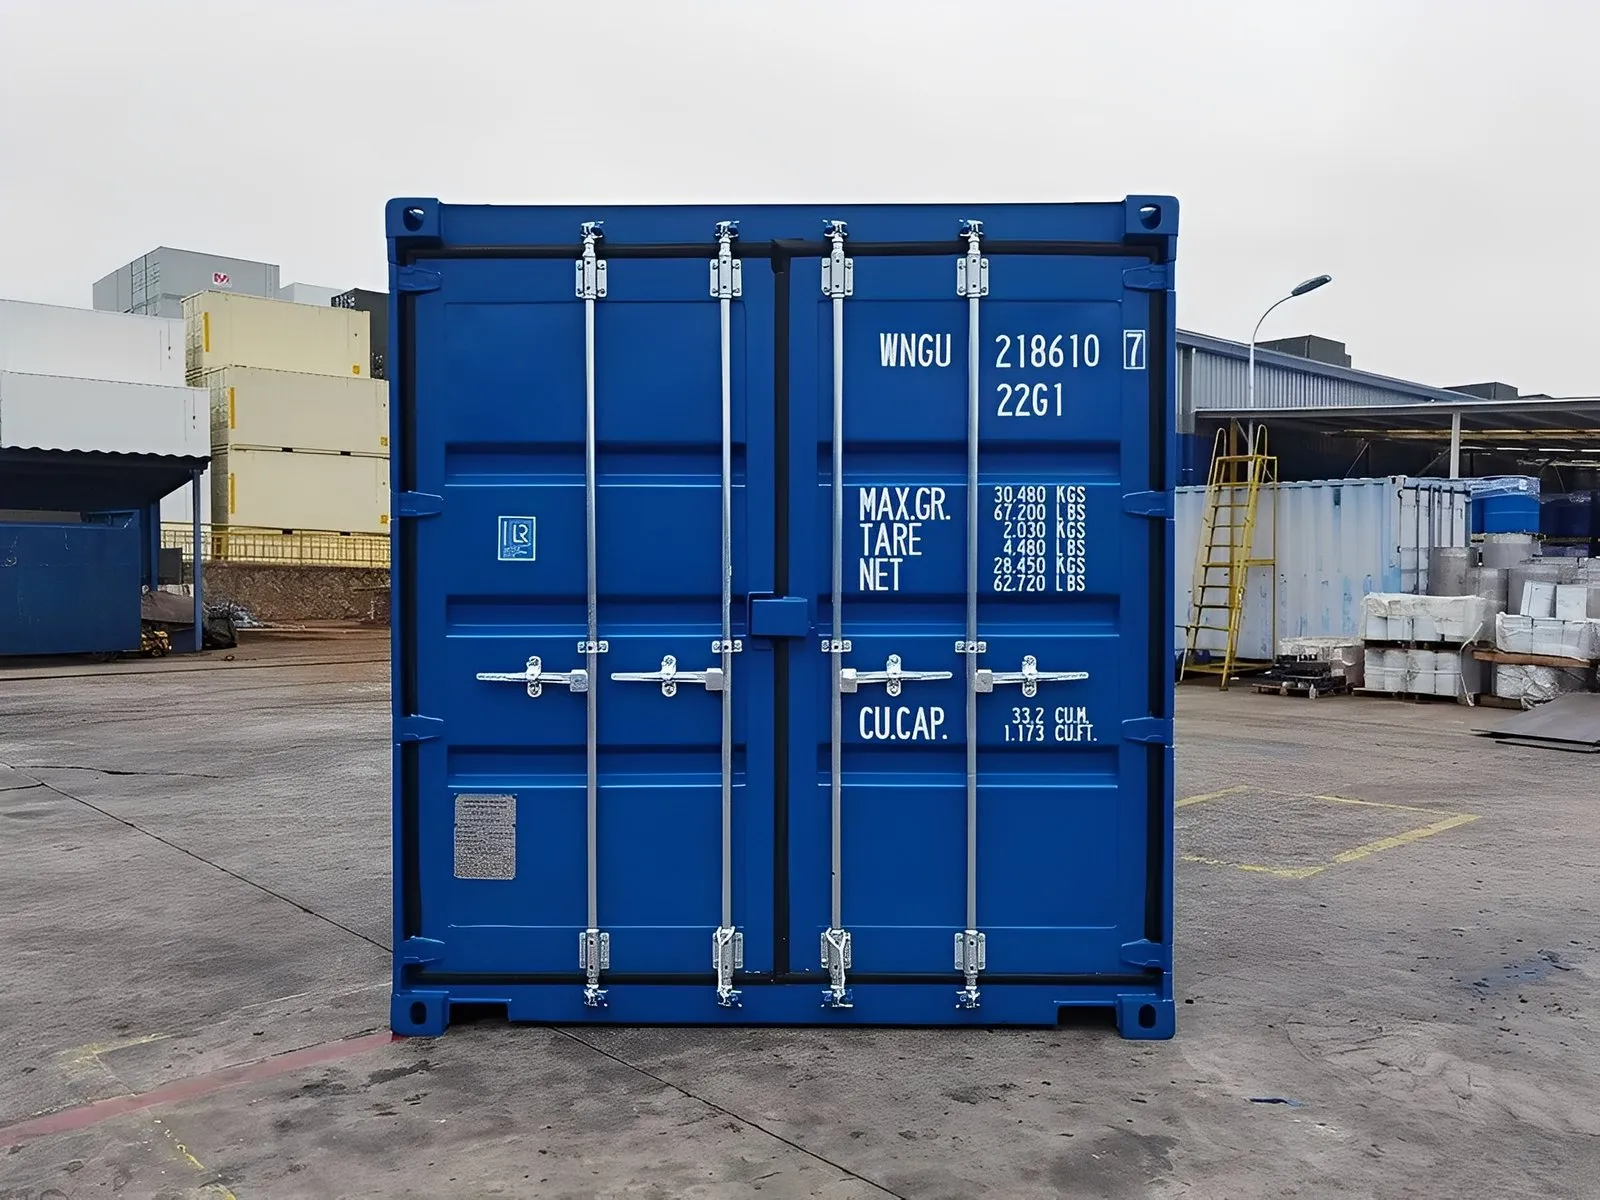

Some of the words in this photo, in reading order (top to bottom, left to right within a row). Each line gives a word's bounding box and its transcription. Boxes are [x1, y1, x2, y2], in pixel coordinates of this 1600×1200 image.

[879, 332, 951, 368] WNGU
[995, 333, 1100, 369] 218610
[1127, 332, 1142, 367] 7
[996, 382, 1062, 417] 22G1
[1056, 485, 1086, 503] KGS
[859, 486, 951, 521] MAX.GR.
[1056, 503, 1086, 521] LBS
[859, 522, 923, 556] TARE
[1056, 521, 1086, 539] KGS
[1056, 538, 1086, 556] LBS
[859, 557, 904, 591] NET
[1056, 556, 1086, 574] KGS
[1056, 574, 1086, 592] LBS
[859, 706, 948, 740] CU.CAP.
[1012, 707, 1045, 724] 33.2
